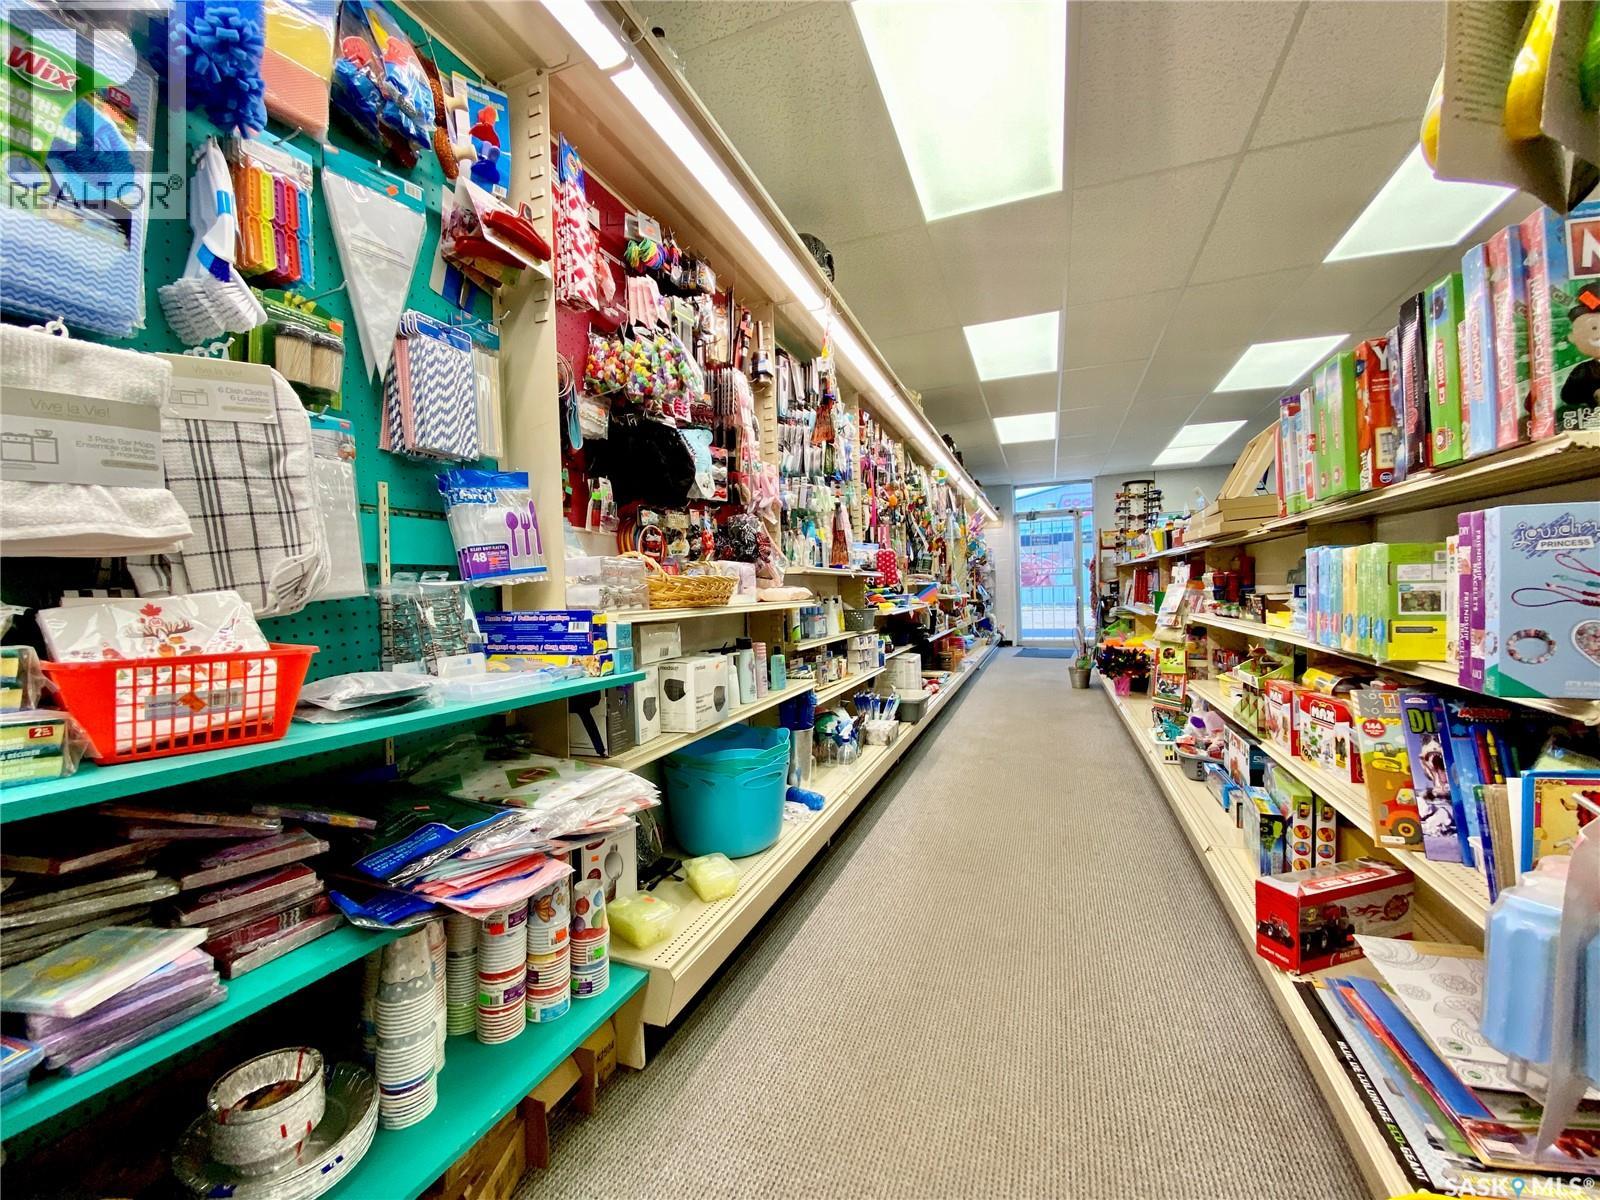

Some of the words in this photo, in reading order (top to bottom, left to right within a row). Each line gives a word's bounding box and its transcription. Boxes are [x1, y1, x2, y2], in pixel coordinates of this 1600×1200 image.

[8, 45, 77, 92] Wix
[1531, 280, 1547, 376] MONOPOLY
[1435, 342, 1445, 384] HOCKEY
[31, 398, 62, 414] Vive
[67, 402, 80, 415] la
[84, 405, 111, 418] Vie!
[95, 436, 115, 444] Pack
[118, 438, 132, 446] Bar
[1541, 538, 1591, 548] PRINCESS
[472, 552, 488, 563] 48
[1270, 688, 1283, 705] MAX
[1311, 702, 1336, 725] MAX
[1357, 1070, 1394, 1124] COLORIAGE
